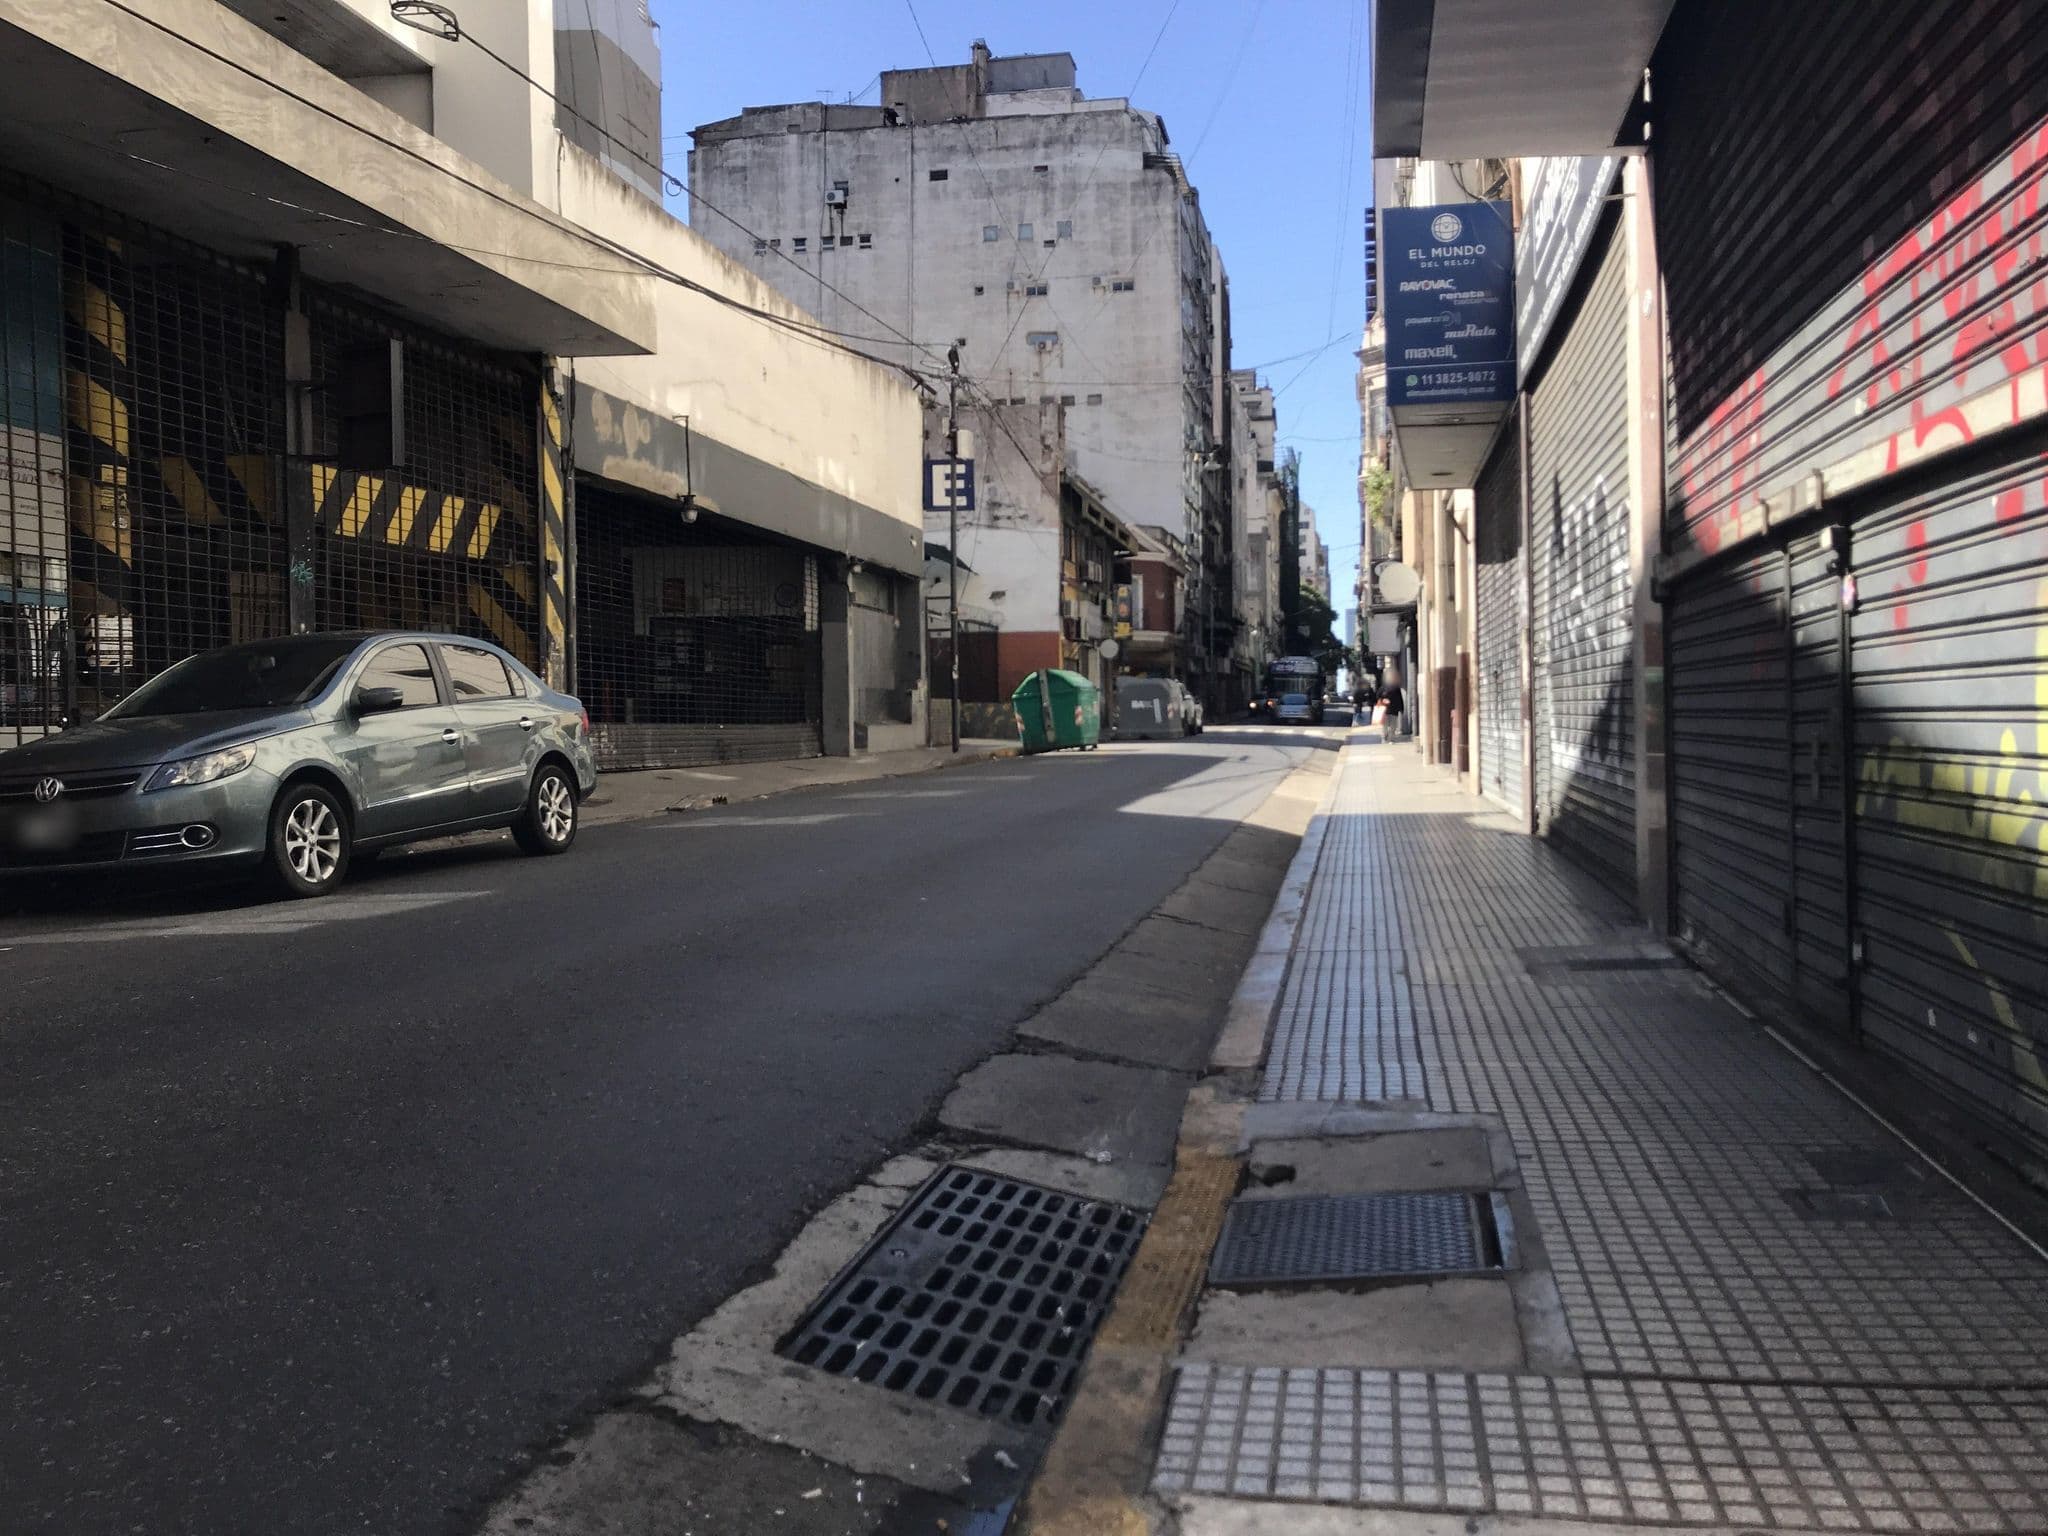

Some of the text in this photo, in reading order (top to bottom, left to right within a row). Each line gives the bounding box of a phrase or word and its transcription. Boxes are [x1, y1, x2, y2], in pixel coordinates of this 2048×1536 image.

[1408, 244, 1487, 260] EL MUNDO
[1444, 258, 1476, 267] RELOJ
[1399, 278, 1455, 292] RAYOVAC
[1439, 290, 1486, 301] renata
[1405, 344, 1454, 360] maxell
[1421, 374, 1433, 386] 11
[932, 464, 967, 506] E
